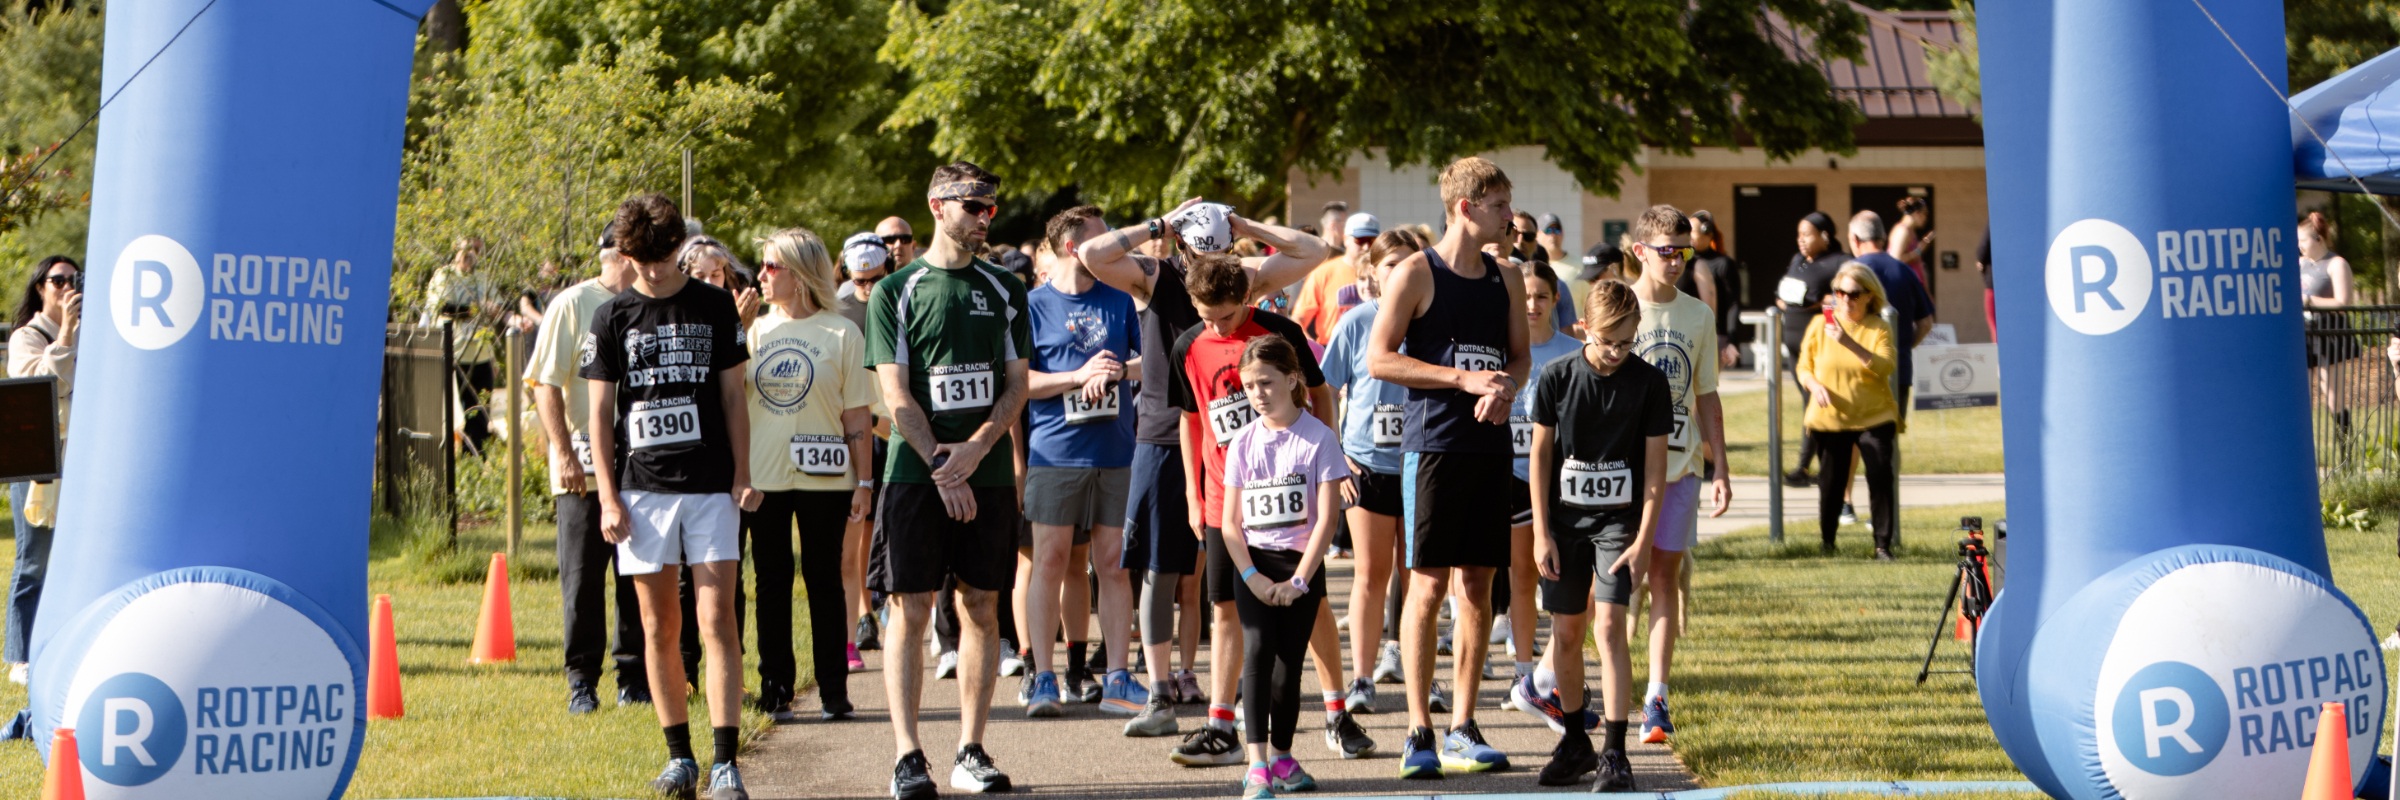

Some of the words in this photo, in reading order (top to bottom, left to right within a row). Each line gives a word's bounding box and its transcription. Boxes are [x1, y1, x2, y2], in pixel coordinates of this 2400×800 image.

[2157, 228, 2282, 272] ROTPAC
[213, 253, 351, 300] ROTPAC
[2161, 271, 2283, 319] RACING
[210, 298, 344, 345] RACING
[657, 323, 713, 337] BELIEVE
[658, 337, 713, 351] THERE'S
[1084, 326, 1109, 350] MIAMI
[1459, 344, 1485, 353] ROTPAC
[659, 351, 693, 366] GOOD
[694, 352, 712, 365] IN
[934, 364, 963, 375] ROTPAC
[965, 361, 990, 371] RACING
[628, 366, 710, 388] DETROIT
[936, 377, 989, 403] 1311
[632, 400, 660, 412] ROTPAC
[662, 395, 691, 407] RACING
[1377, 404, 1403, 412] ROTPAC
[634, 411, 695, 439] 1390
[1214, 404, 1259, 433] 137
[794, 434, 820, 442] ROTPAC
[821, 435, 844, 443] RACING
[795, 447, 845, 467] 1340
[1566, 461, 1596, 471] ROTPAC
[1597, 460, 1626, 471] RACING
[1245, 477, 1272, 490] ROTPAC
[1272, 474, 1302, 487] RACING
[1566, 475, 1626, 498] 1497
[1247, 491, 1304, 517] 1318
[2232, 649, 2373, 704] ROTPAC
[196, 684, 344, 728] ROTPAC
[2239, 695, 2370, 757] RACG
[195, 726, 335, 775] RACING
